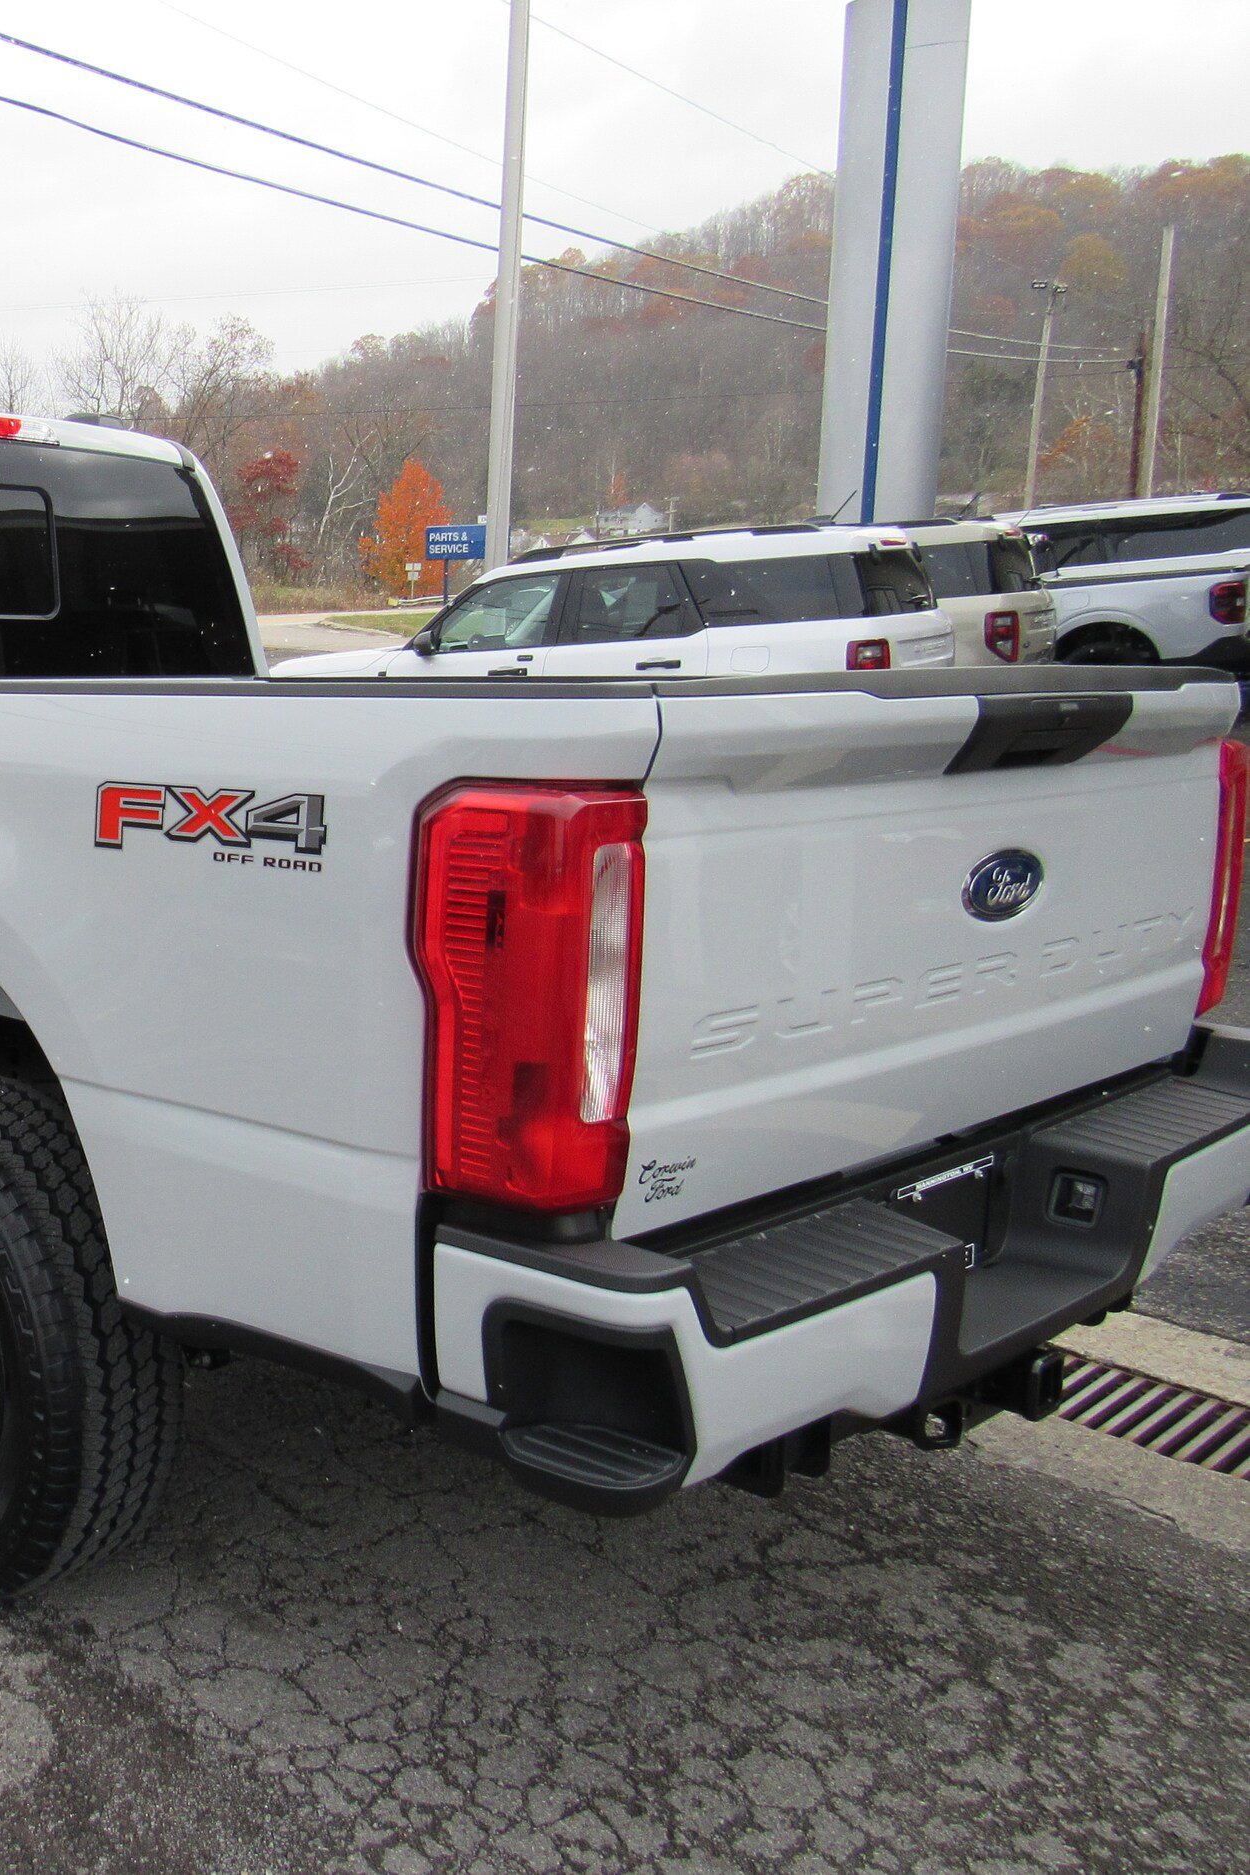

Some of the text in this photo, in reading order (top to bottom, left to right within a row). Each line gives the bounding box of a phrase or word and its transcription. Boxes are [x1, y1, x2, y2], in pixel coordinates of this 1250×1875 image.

[429, 531, 468, 542] PARTS &
[429, 543, 469, 554] SERVICE
[94, 781, 327, 855] FX4
[213, 851, 322, 873] OFF ROAD
[987, 866, 1032, 907] Ford
[691, 905, 1196, 1060] SUPER DUTY
[638, 1155, 697, 1185] Corwin
[644, 1177, 686, 1203] Ford
